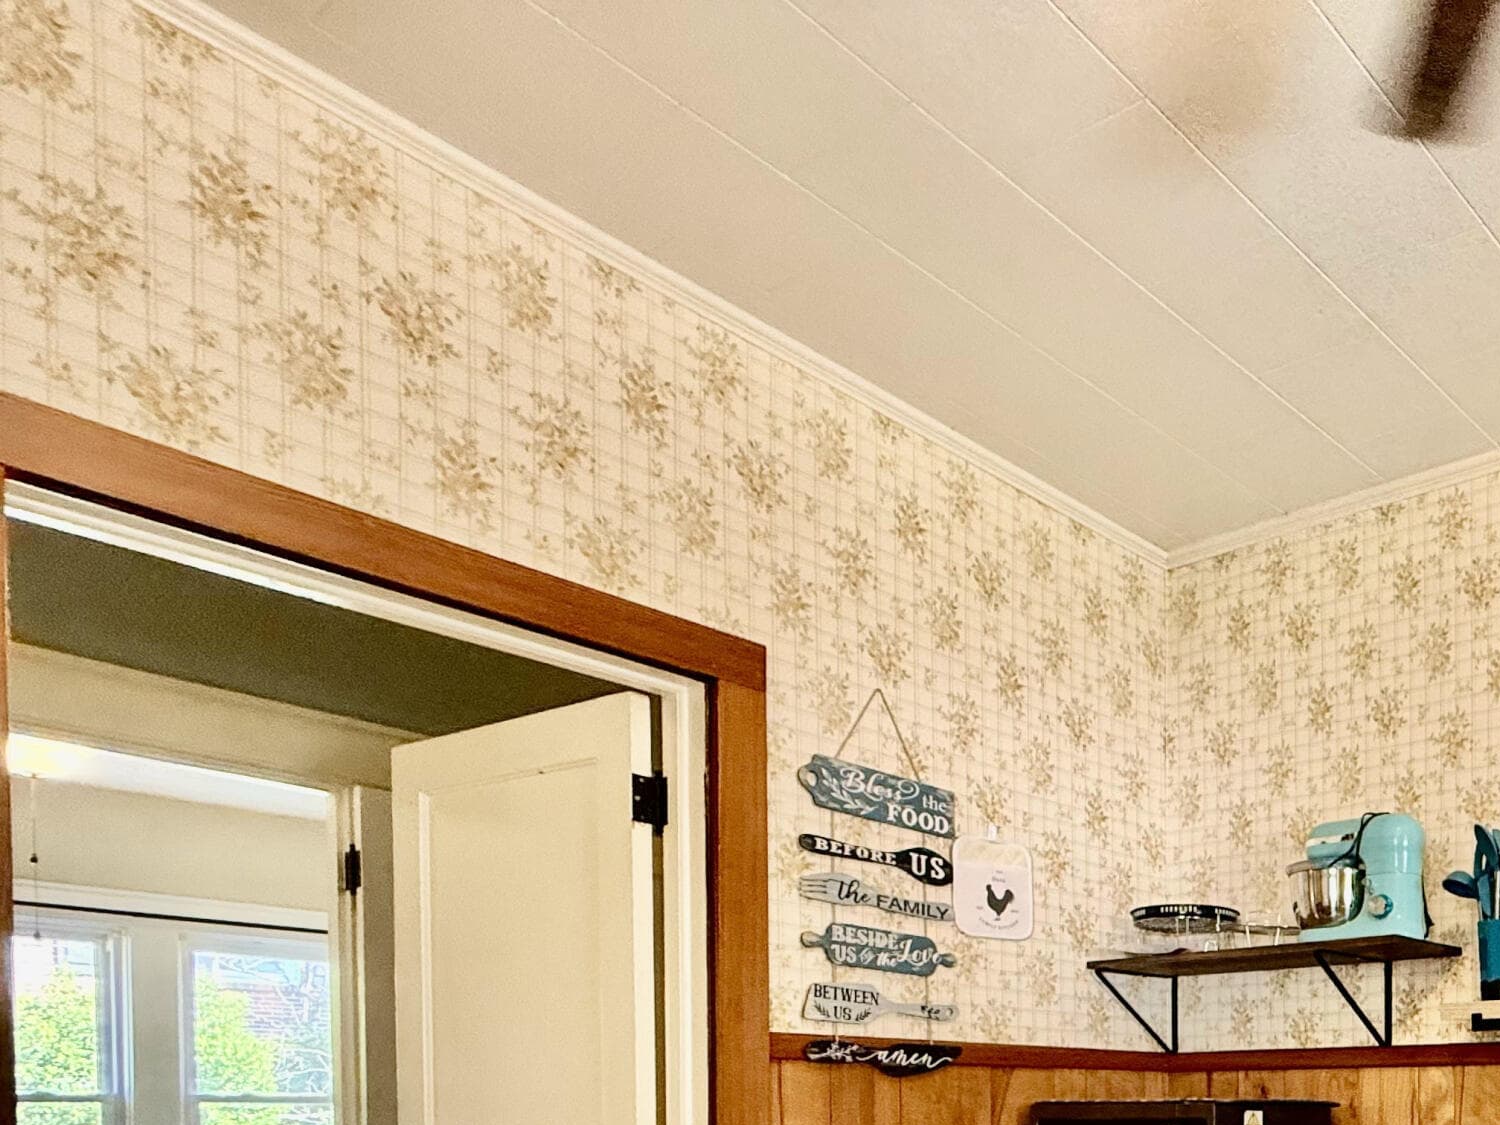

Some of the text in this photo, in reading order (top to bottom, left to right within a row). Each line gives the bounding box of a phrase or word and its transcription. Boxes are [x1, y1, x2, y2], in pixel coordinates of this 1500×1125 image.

[840, 768, 947, 813] Bless the
[887, 802, 949, 834] FOOD
[814, 837, 946, 880] BEFORE US
[838, 879, 949, 919] the FAMILY
[830, 944, 857, 964] US
[831, 924, 942, 966] BESIDE Love
[813, 983, 880, 1006] BETWEEN
[833, 1005, 852, 1021] US
[857, 1049, 952, 1069] amen
